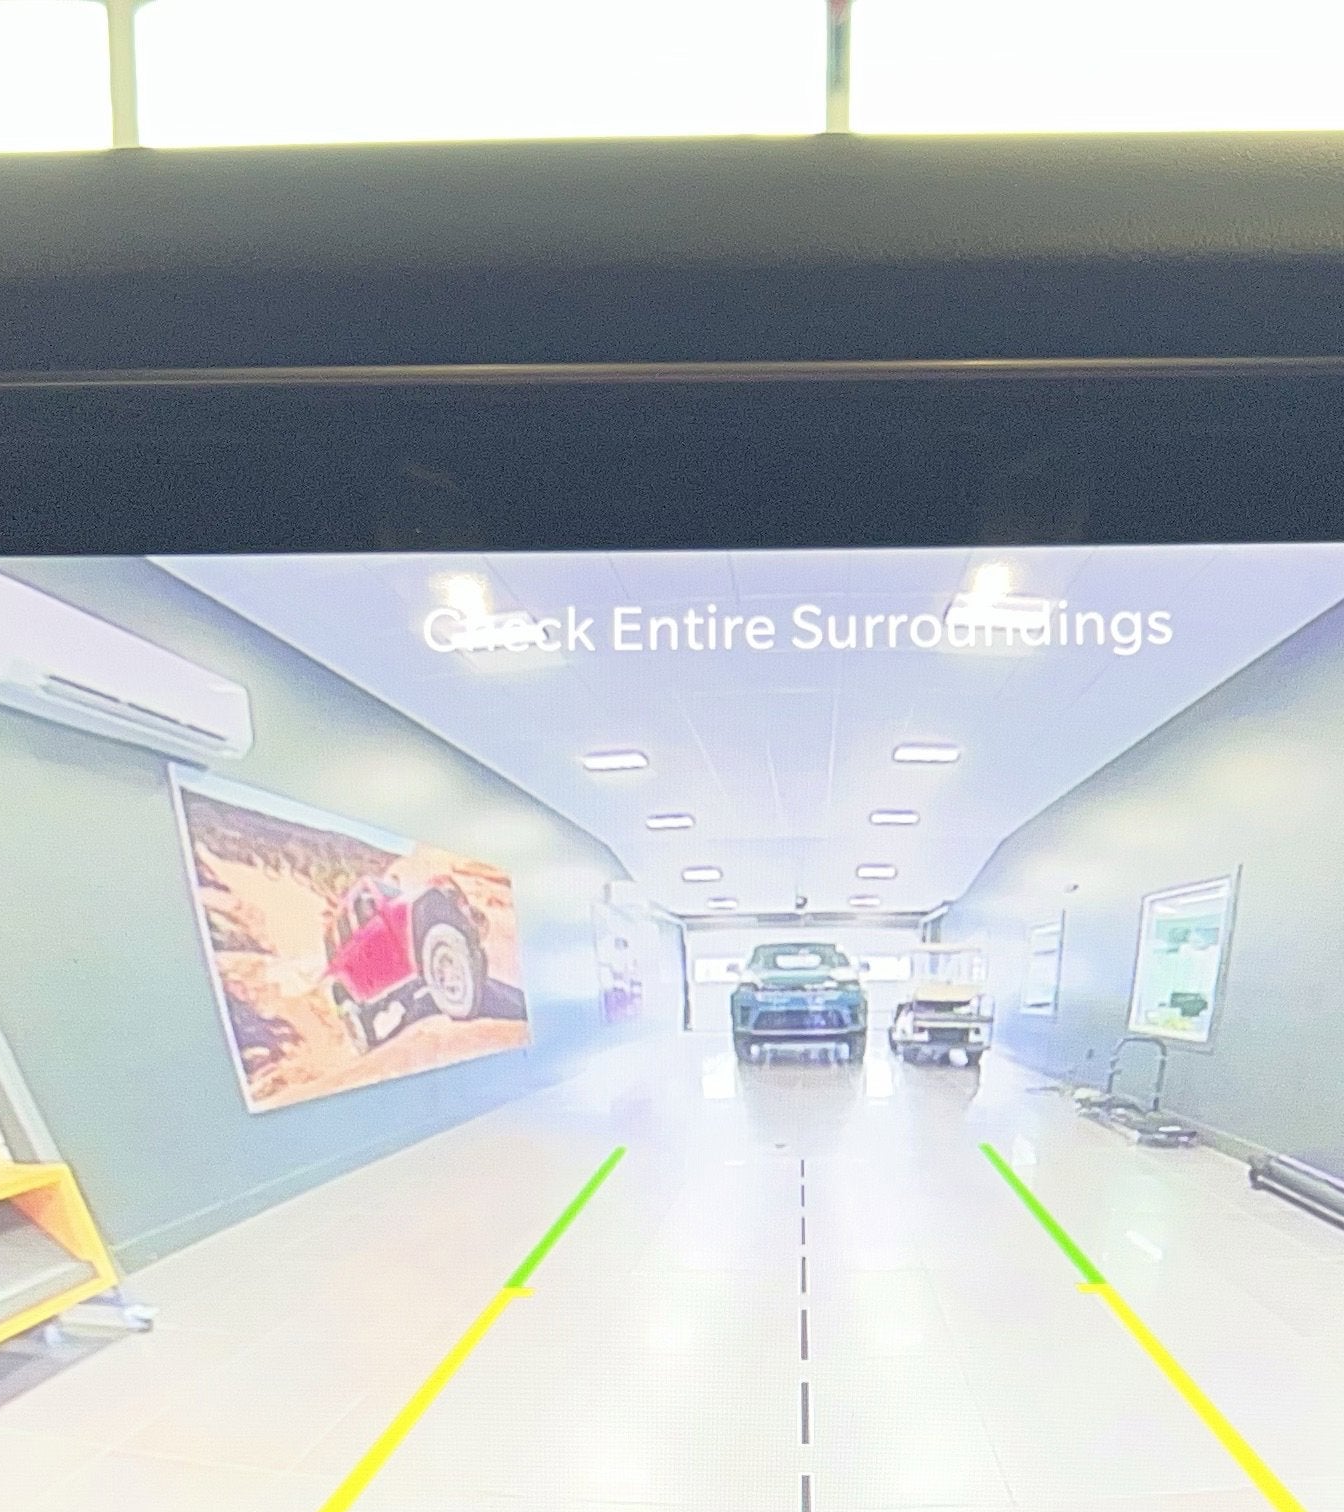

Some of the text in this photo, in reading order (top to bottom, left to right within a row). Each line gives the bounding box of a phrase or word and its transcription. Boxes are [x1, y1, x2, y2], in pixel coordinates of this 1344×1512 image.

[423, 600, 1173, 655] Check Entire Surroundings
